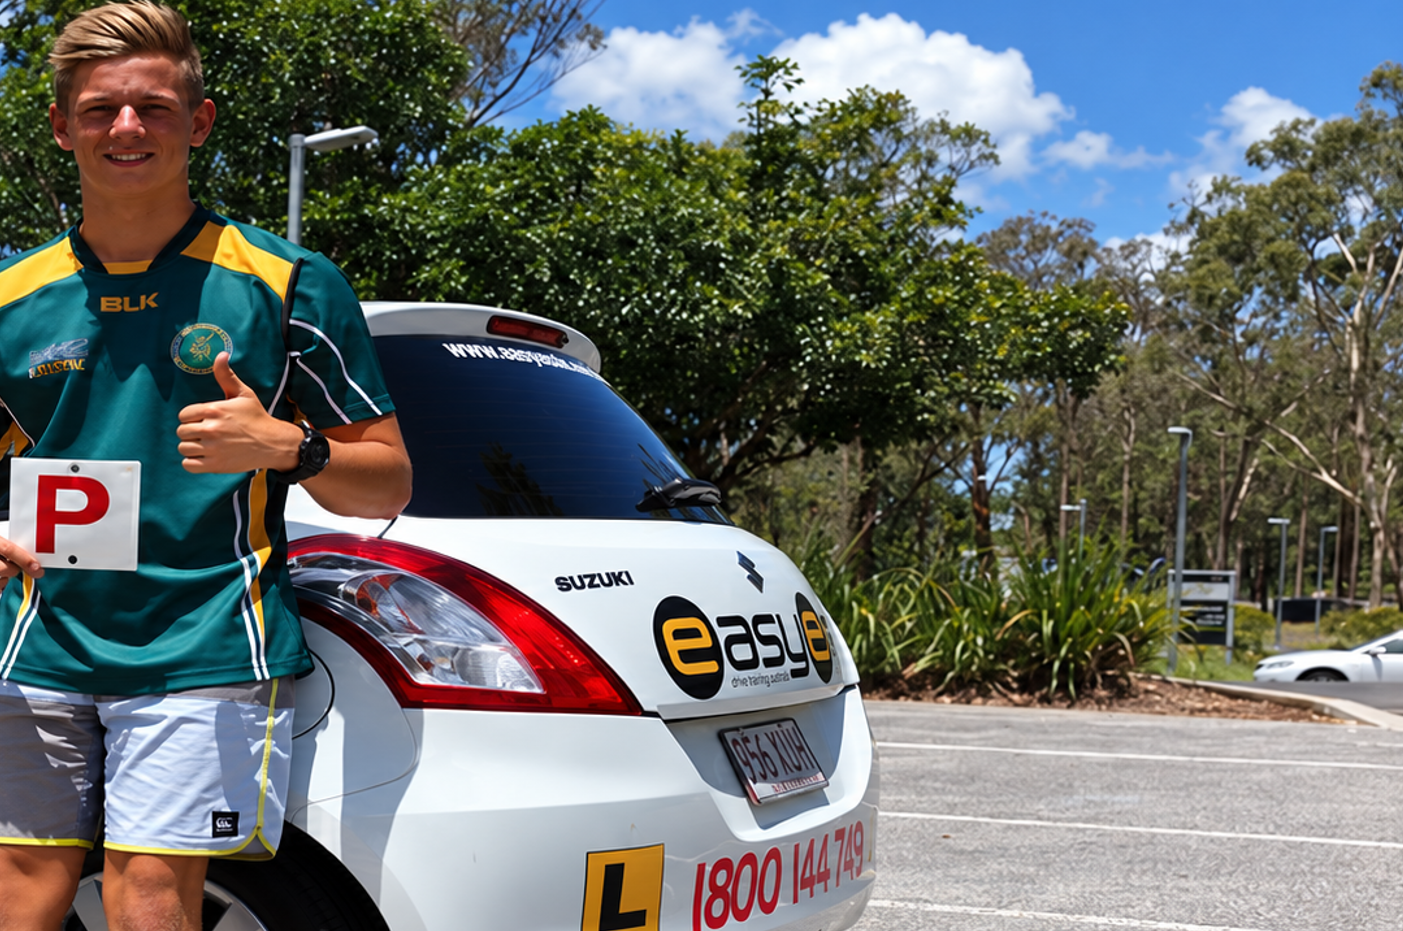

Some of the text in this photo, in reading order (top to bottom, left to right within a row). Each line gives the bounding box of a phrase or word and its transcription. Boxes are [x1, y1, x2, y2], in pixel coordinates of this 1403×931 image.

[100, 292, 159, 312] BLK
[35, 474, 111, 554] P
[554, 570, 635, 592] SUZUKI
[598, 862, 647, 931] L
[692, 820, 864, 931] 1800 144 749
